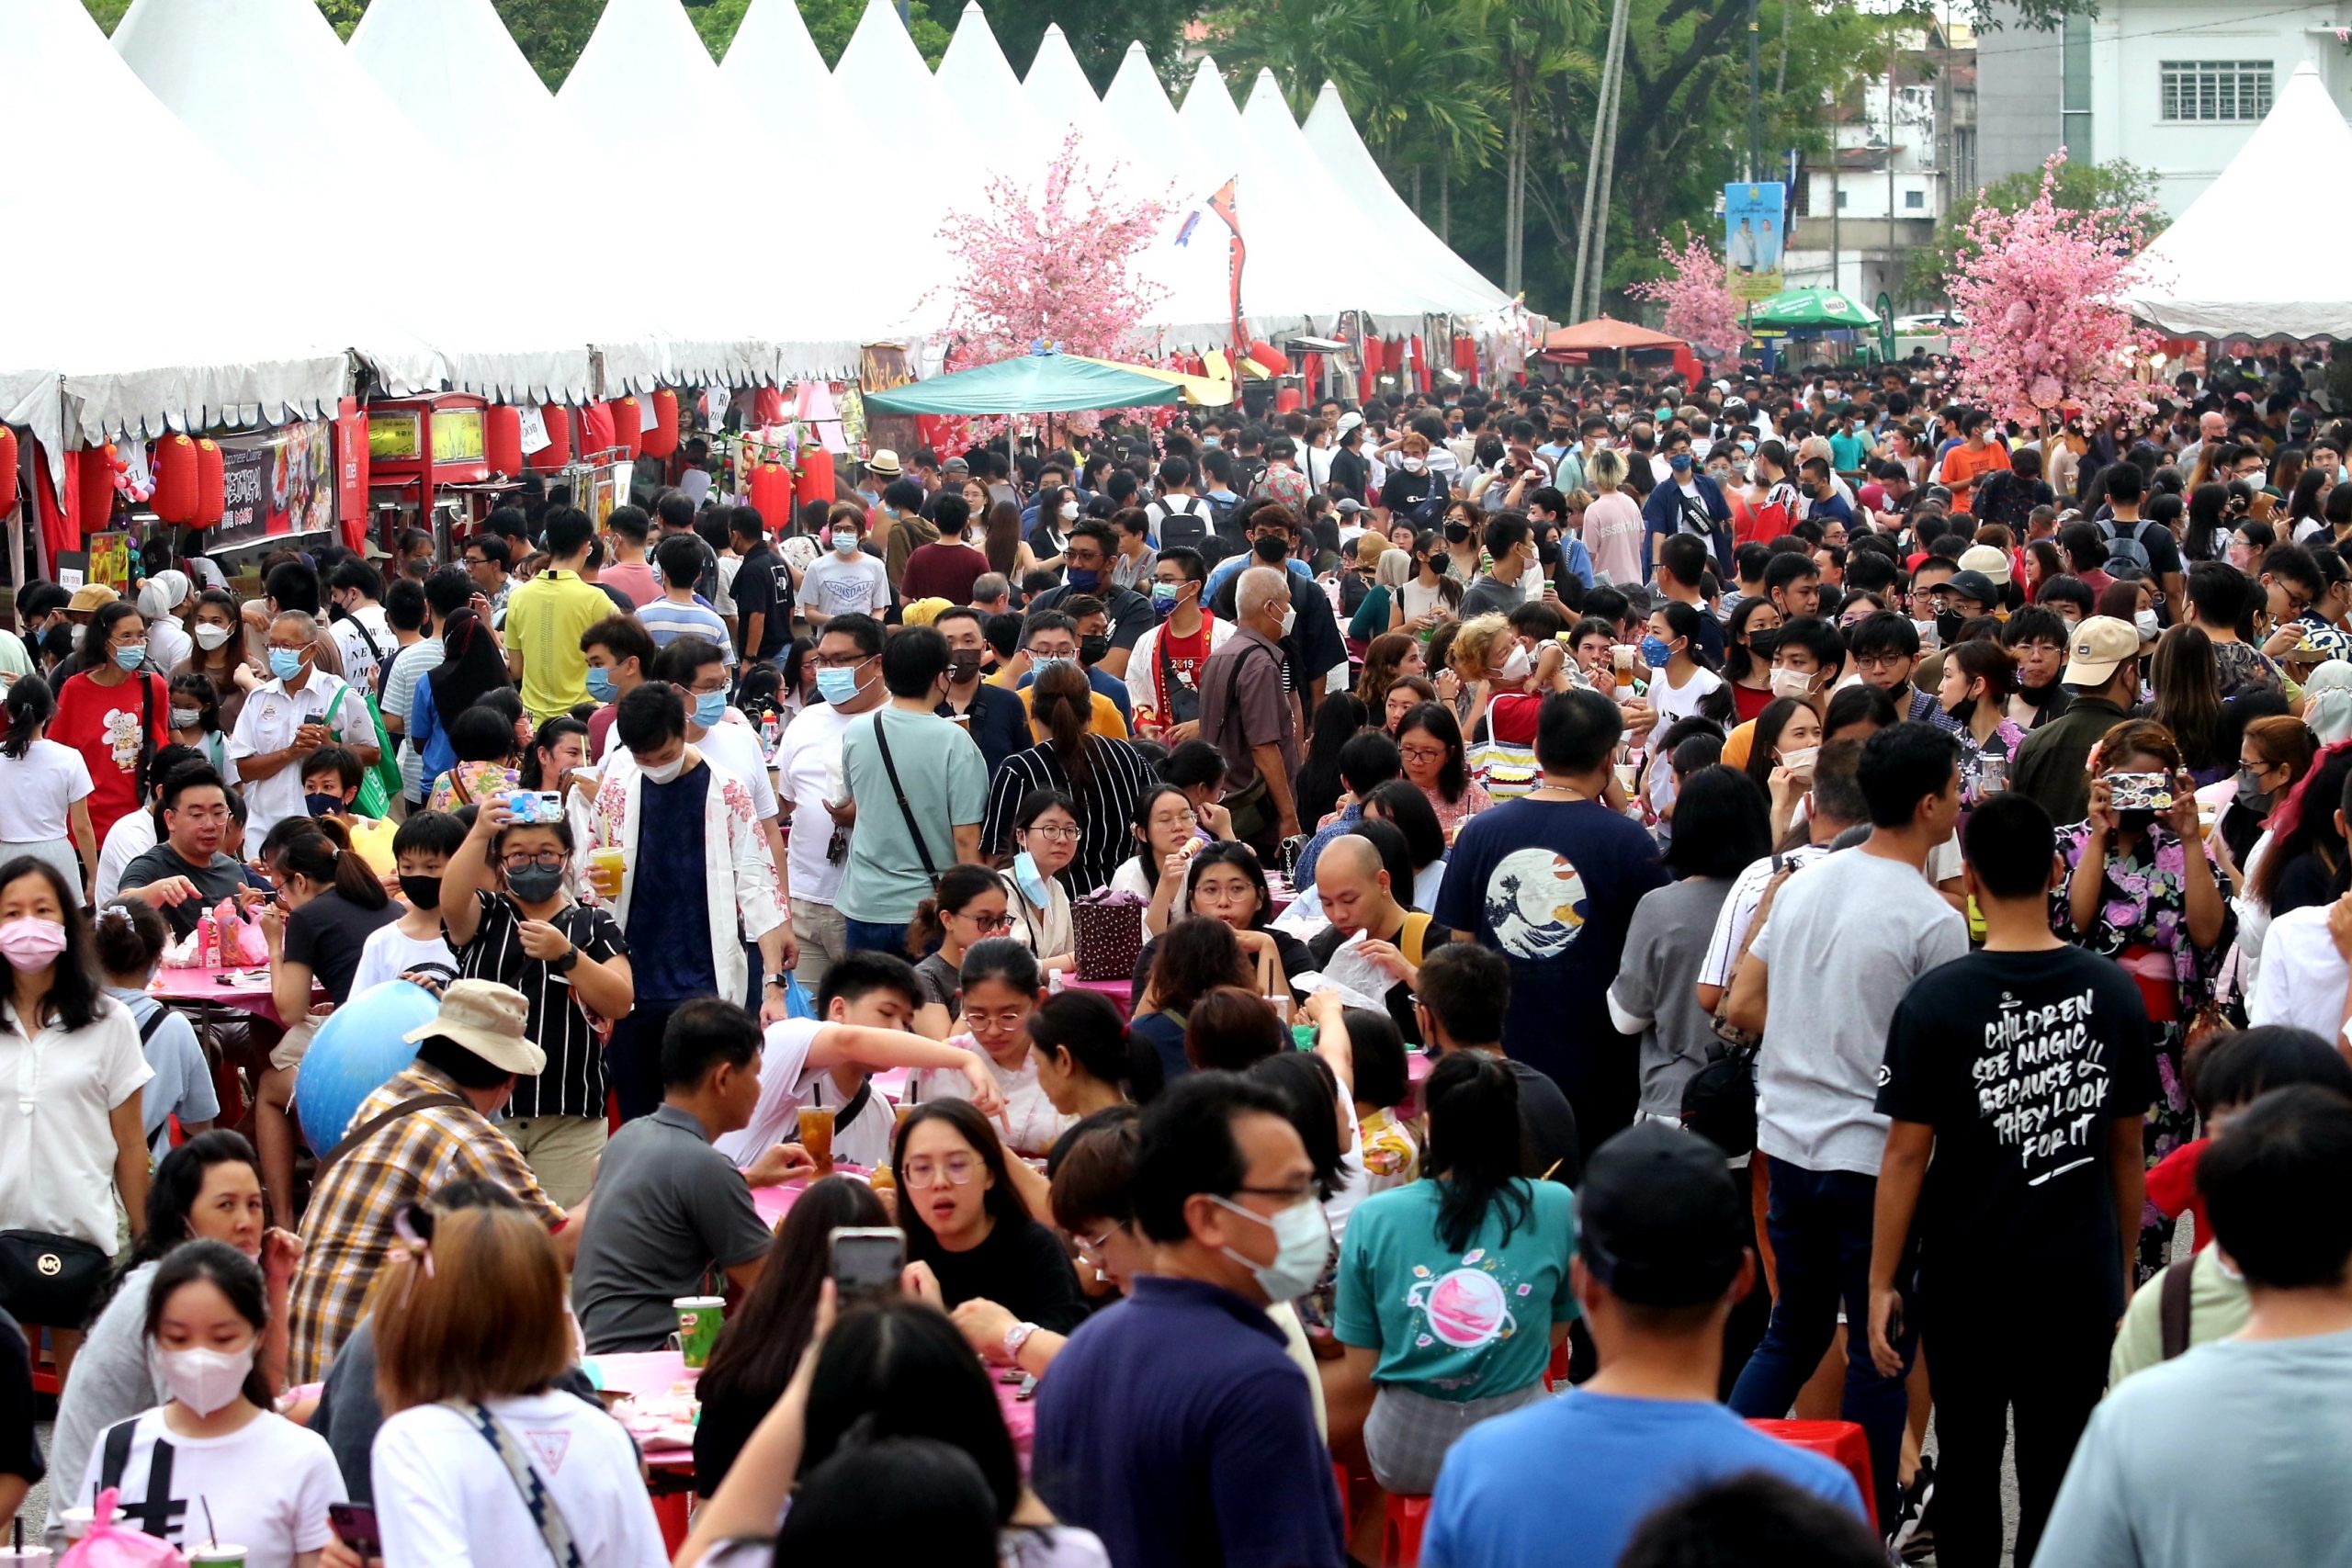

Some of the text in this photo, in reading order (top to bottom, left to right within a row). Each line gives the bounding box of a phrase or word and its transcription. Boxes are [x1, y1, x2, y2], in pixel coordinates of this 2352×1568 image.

[352, 647, 395, 661] NEER
[1985, 988, 2093, 1051] CHILDREN
[1972, 1022, 2087, 1089] SEE MAGIC
[1978, 1061, 2073, 1119] BECAUSE
[1993, 1077, 2109, 1145] THEY LOOK
[2022, 1113, 2096, 1168] FOR IT
